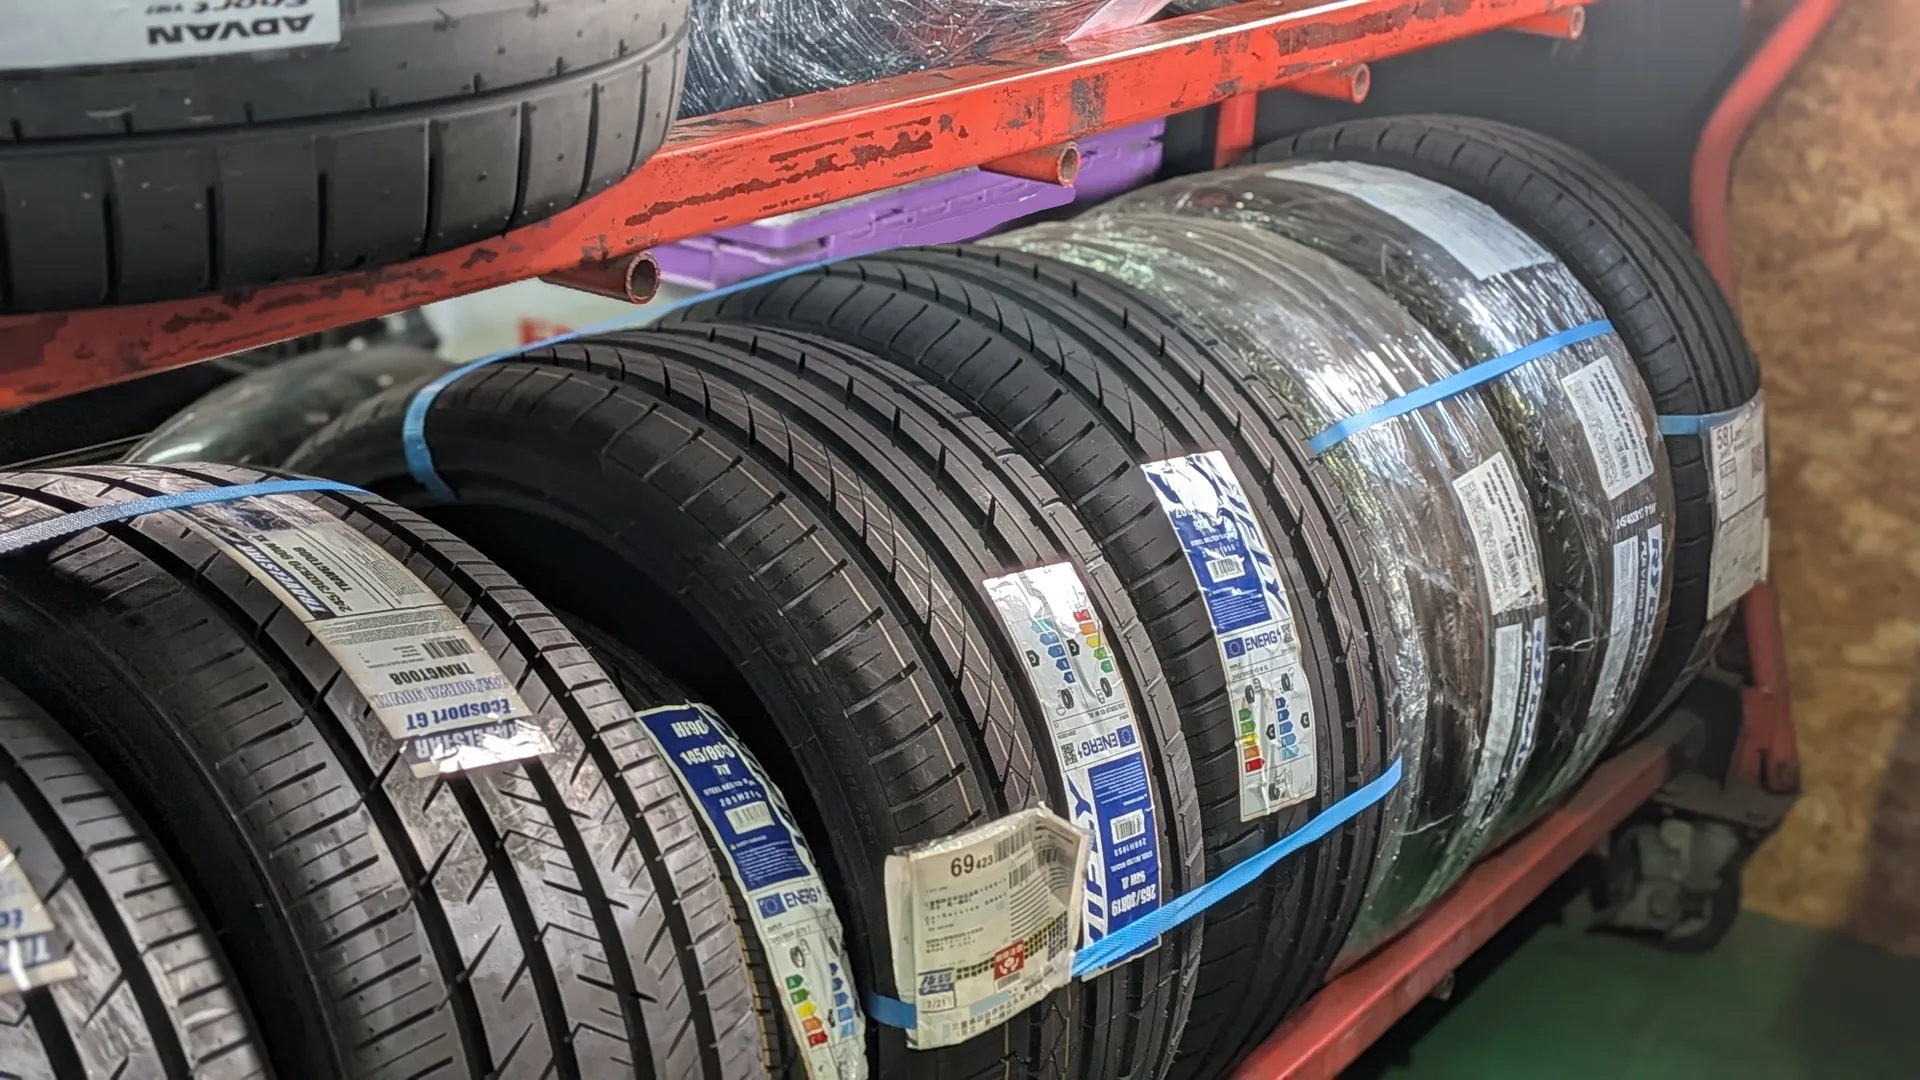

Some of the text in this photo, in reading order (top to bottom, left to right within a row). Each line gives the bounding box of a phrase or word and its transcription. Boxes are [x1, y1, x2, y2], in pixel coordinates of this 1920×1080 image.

[147, 14, 314, 45] ADVAN
[236, 543, 328, 613] TRAVELSTAR
[292, 546, 353, 593] TRAVGT008
[1244, 630, 1279, 651] ENERG
[389, 662, 475, 685] TRAVGT008
[406, 698, 512, 731] Ecosport GT
[1081, 732, 1118, 756] ENERG
[950, 853, 994, 878] 69 423
[1111, 883, 1157, 917] 265/30R19
